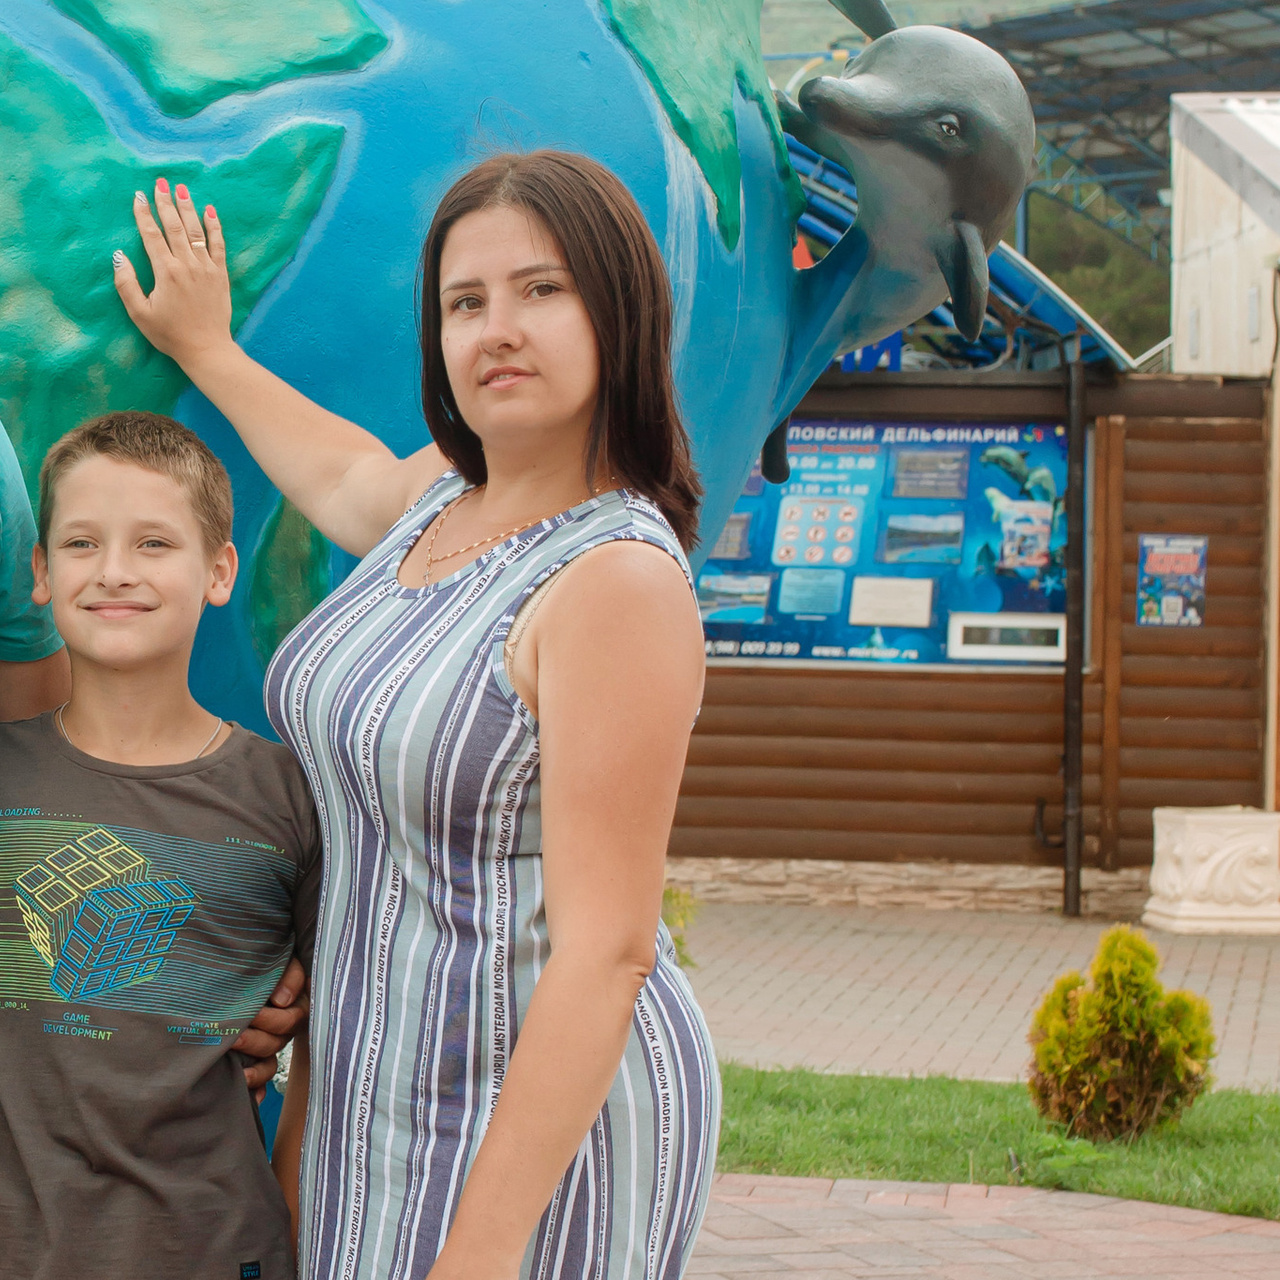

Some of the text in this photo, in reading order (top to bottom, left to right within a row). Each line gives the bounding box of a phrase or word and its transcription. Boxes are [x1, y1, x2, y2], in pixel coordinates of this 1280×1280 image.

[881, 425, 1019, 443] ДЕЛЬФИНАРИЙ
[463, 559, 507, 606] ATERDAM
[332, 595, 379, 638] STOCKHOLM
[433, 605, 465, 638] MOSCOW
[310, 638, 333, 668] MADRID
[408, 637, 435, 666] MADRID
[296, 668, 312, 708] MOSCOW
[373, 666, 410, 716] STOCKHOLM
[295, 708, 314, 766] AMSTERDAM
[362, 714, 378, 761] BANGKOK
[362, 764, 376, 803] LONDON
[498, 749, 540, 856] BANGKOK LONDON MADRID
[495, 854, 507, 907] STOCKHOL
[380, 893, 398, 941] MOSCOW
[376, 943, 386, 983] MADRID
[493, 944, 506, 988] MOSCOW
[43, 1023, 113, 1041] DEVELOPMENT
[63, 1012, 90, 1024] GAME
[190, 1021, 219, 1029] CREATE
[371, 984, 384, 1047] STOCKHOLM
[493, 990, 505, 1052] AMSTERDAM
[360, 1047, 376, 1099] BANGKOK
[493, 1054, 505, 1090] MADRID
[651, 1045, 669, 1090] LONDON
[356, 1101, 369, 1144] LONDON
[661, 1091, 671, 1134] MADRID
[354, 1145, 365, 1182] MADRID
[657, 1136, 670, 1202] AMSTERDAM
[349, 1183, 362, 1244] AMSTERDAM
[649, 1205, 662, 1253] MOSCOW
